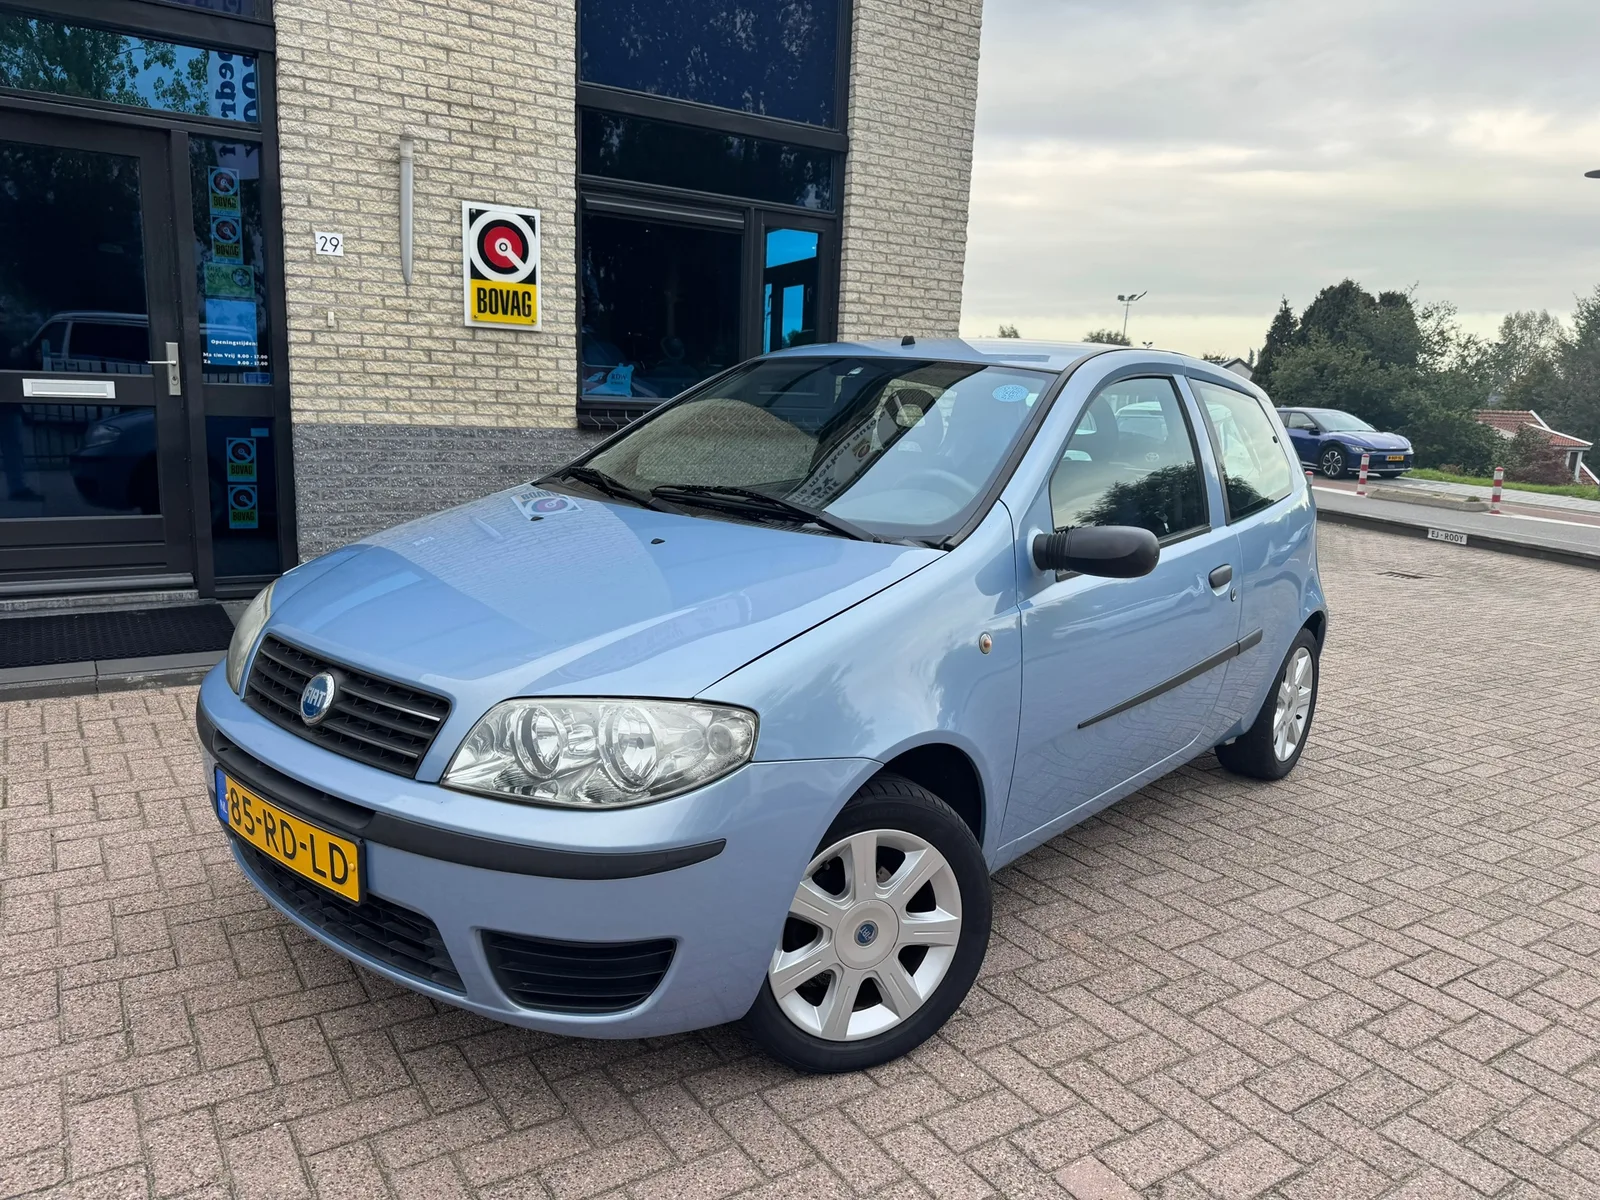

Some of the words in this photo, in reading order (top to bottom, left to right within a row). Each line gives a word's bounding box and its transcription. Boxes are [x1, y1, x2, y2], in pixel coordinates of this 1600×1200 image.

[216, 244, 239, 256] BOVAG
[319, 235, 340, 253] 29
[476, 287, 532, 318] BOVAG
[231, 464, 253, 475] BOVAG
[232, 511, 255, 521] BOVAG
[303, 687, 327, 708] FIAT
[219, 799, 228, 814] NL
[230, 787, 349, 886] 85-RD-LD
